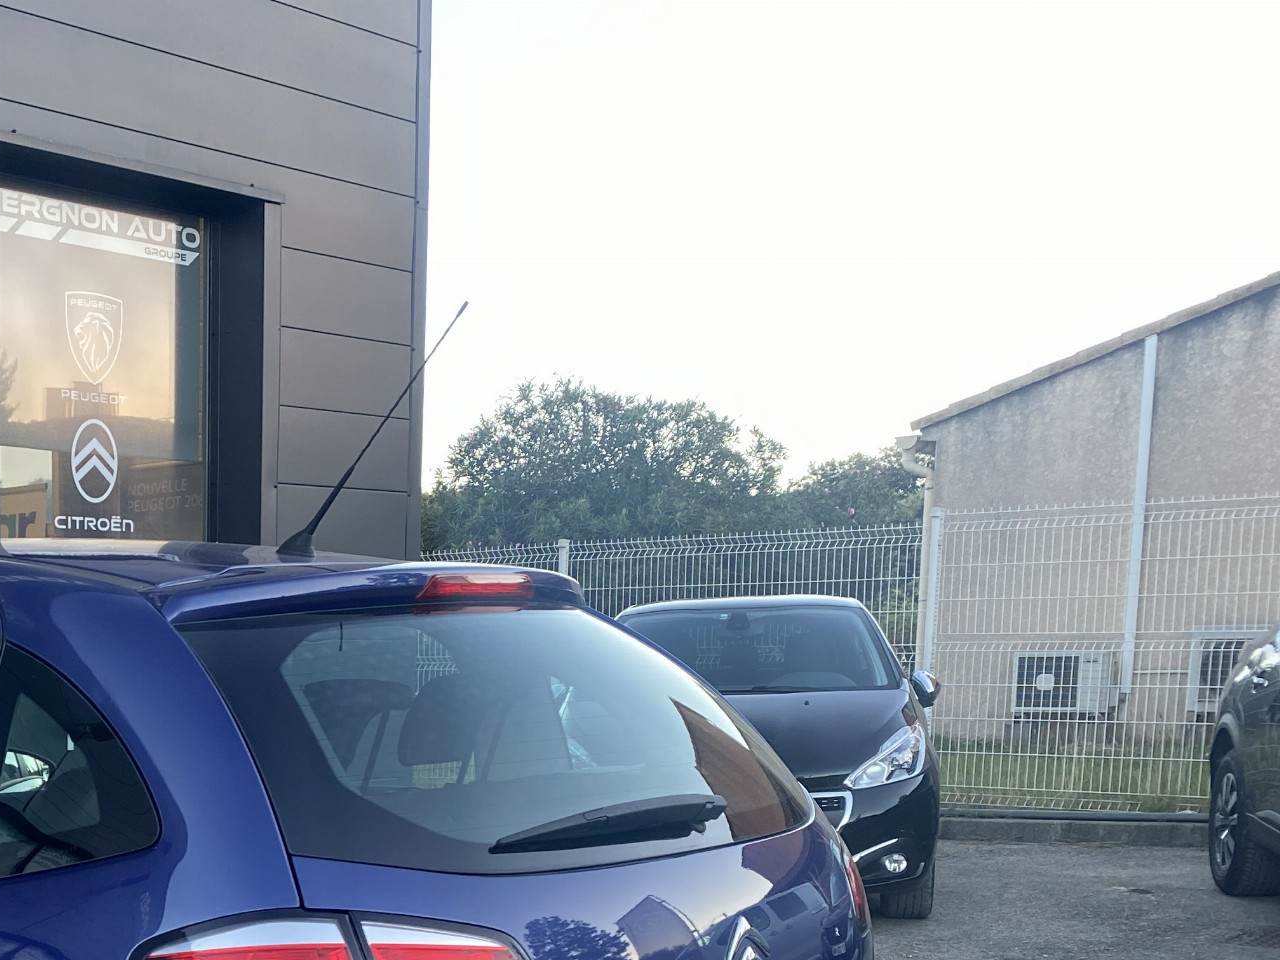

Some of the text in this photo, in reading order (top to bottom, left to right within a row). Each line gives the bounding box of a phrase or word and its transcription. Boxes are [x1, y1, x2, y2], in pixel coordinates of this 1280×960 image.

[126, 217, 201, 249] AUTO
[144, 247, 187, 262] GROUPE
[70, 298, 118, 312] PEUGEOT
[61, 389, 128, 405] PEUGEOT
[128, 478, 189, 496] NOUVELLE
[128, 495, 181, 513] PEUGEOT
